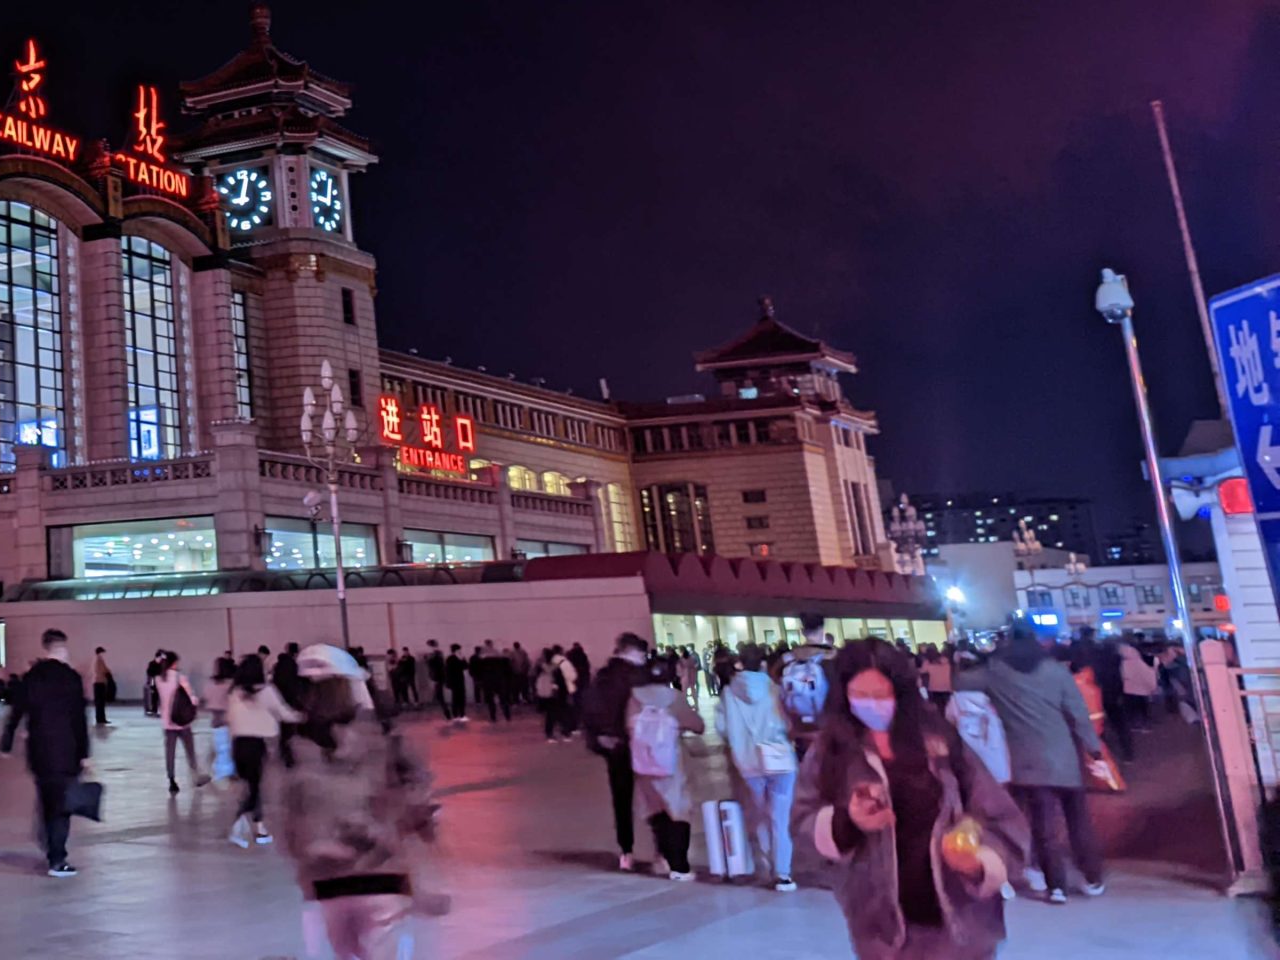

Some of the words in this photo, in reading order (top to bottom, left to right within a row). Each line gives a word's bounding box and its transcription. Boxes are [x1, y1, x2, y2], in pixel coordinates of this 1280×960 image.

[380, 397, 474, 451] 进站口
[401, 445, 466, 474] ENTRANCE
